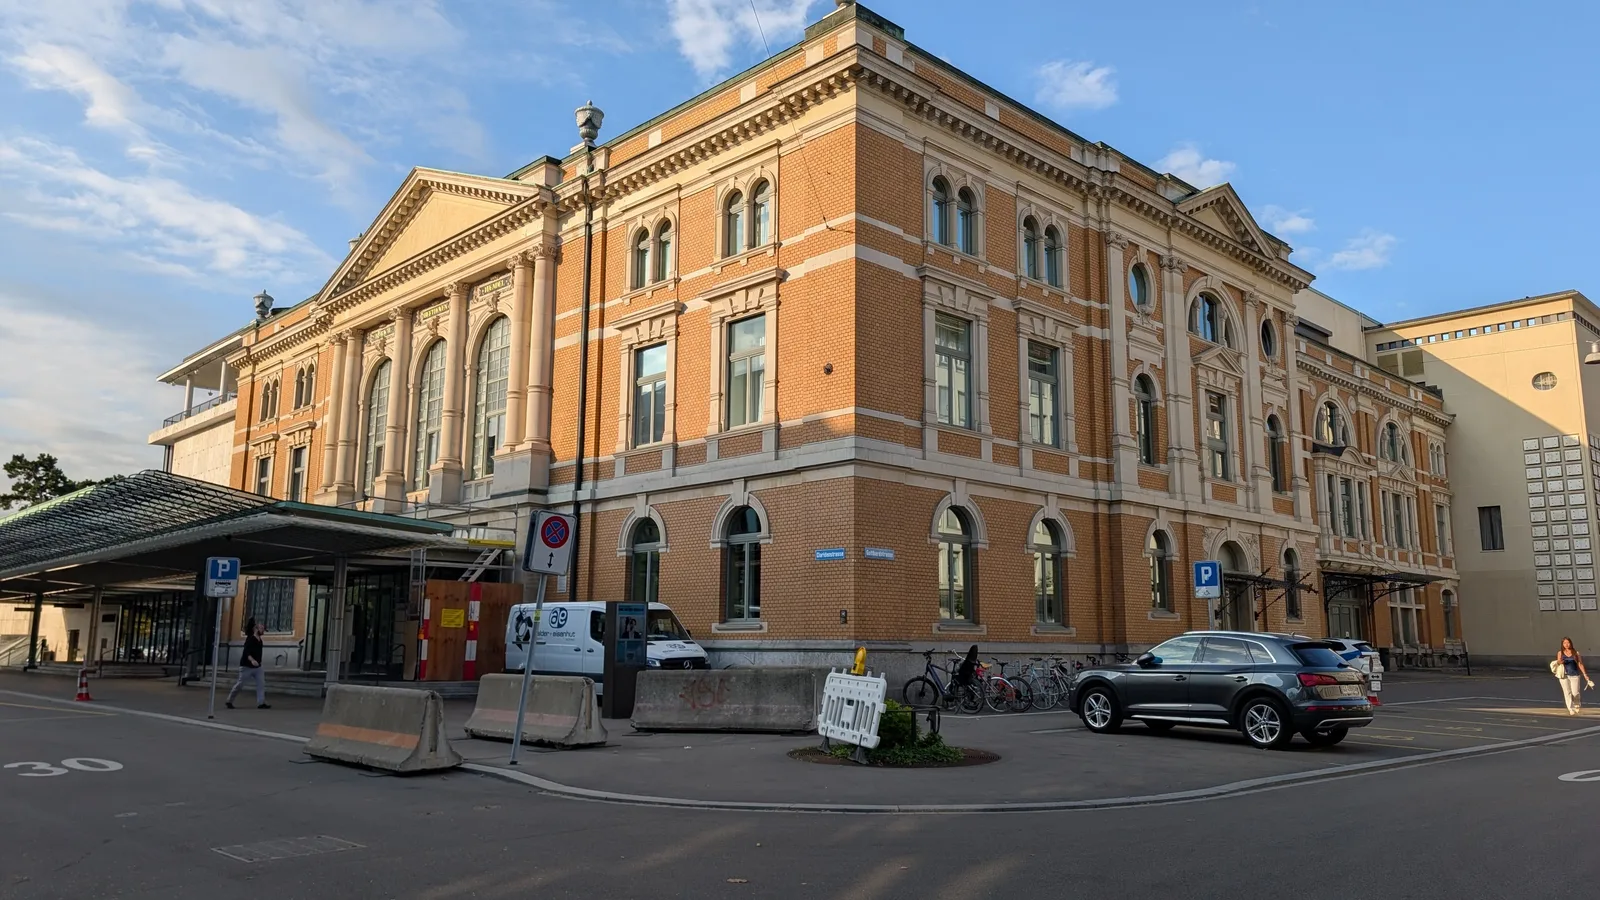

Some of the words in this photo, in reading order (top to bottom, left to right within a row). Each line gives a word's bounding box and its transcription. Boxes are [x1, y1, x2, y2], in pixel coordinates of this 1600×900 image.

[217, 560, 230, 577] P
[1201, 566, 1212, 584] P
[3, 757, 124, 777] 30
